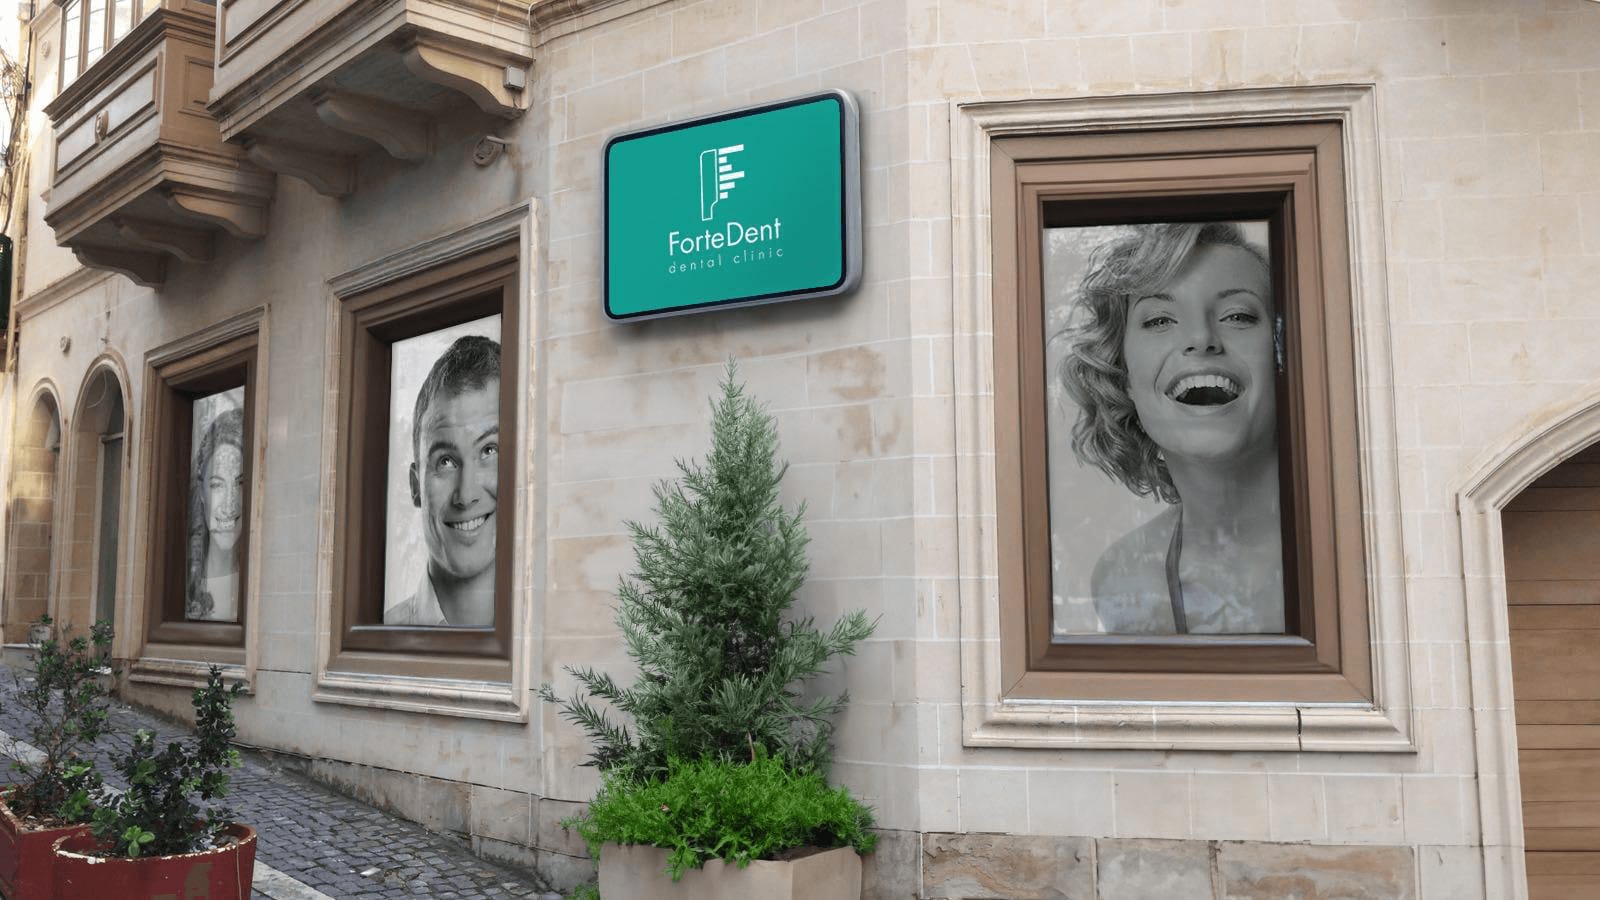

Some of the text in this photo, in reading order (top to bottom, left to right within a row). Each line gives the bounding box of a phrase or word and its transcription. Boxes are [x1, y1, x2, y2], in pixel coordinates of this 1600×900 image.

[669, 218, 781, 256] ForteDent
[668, 248, 784, 274] dental clinic
